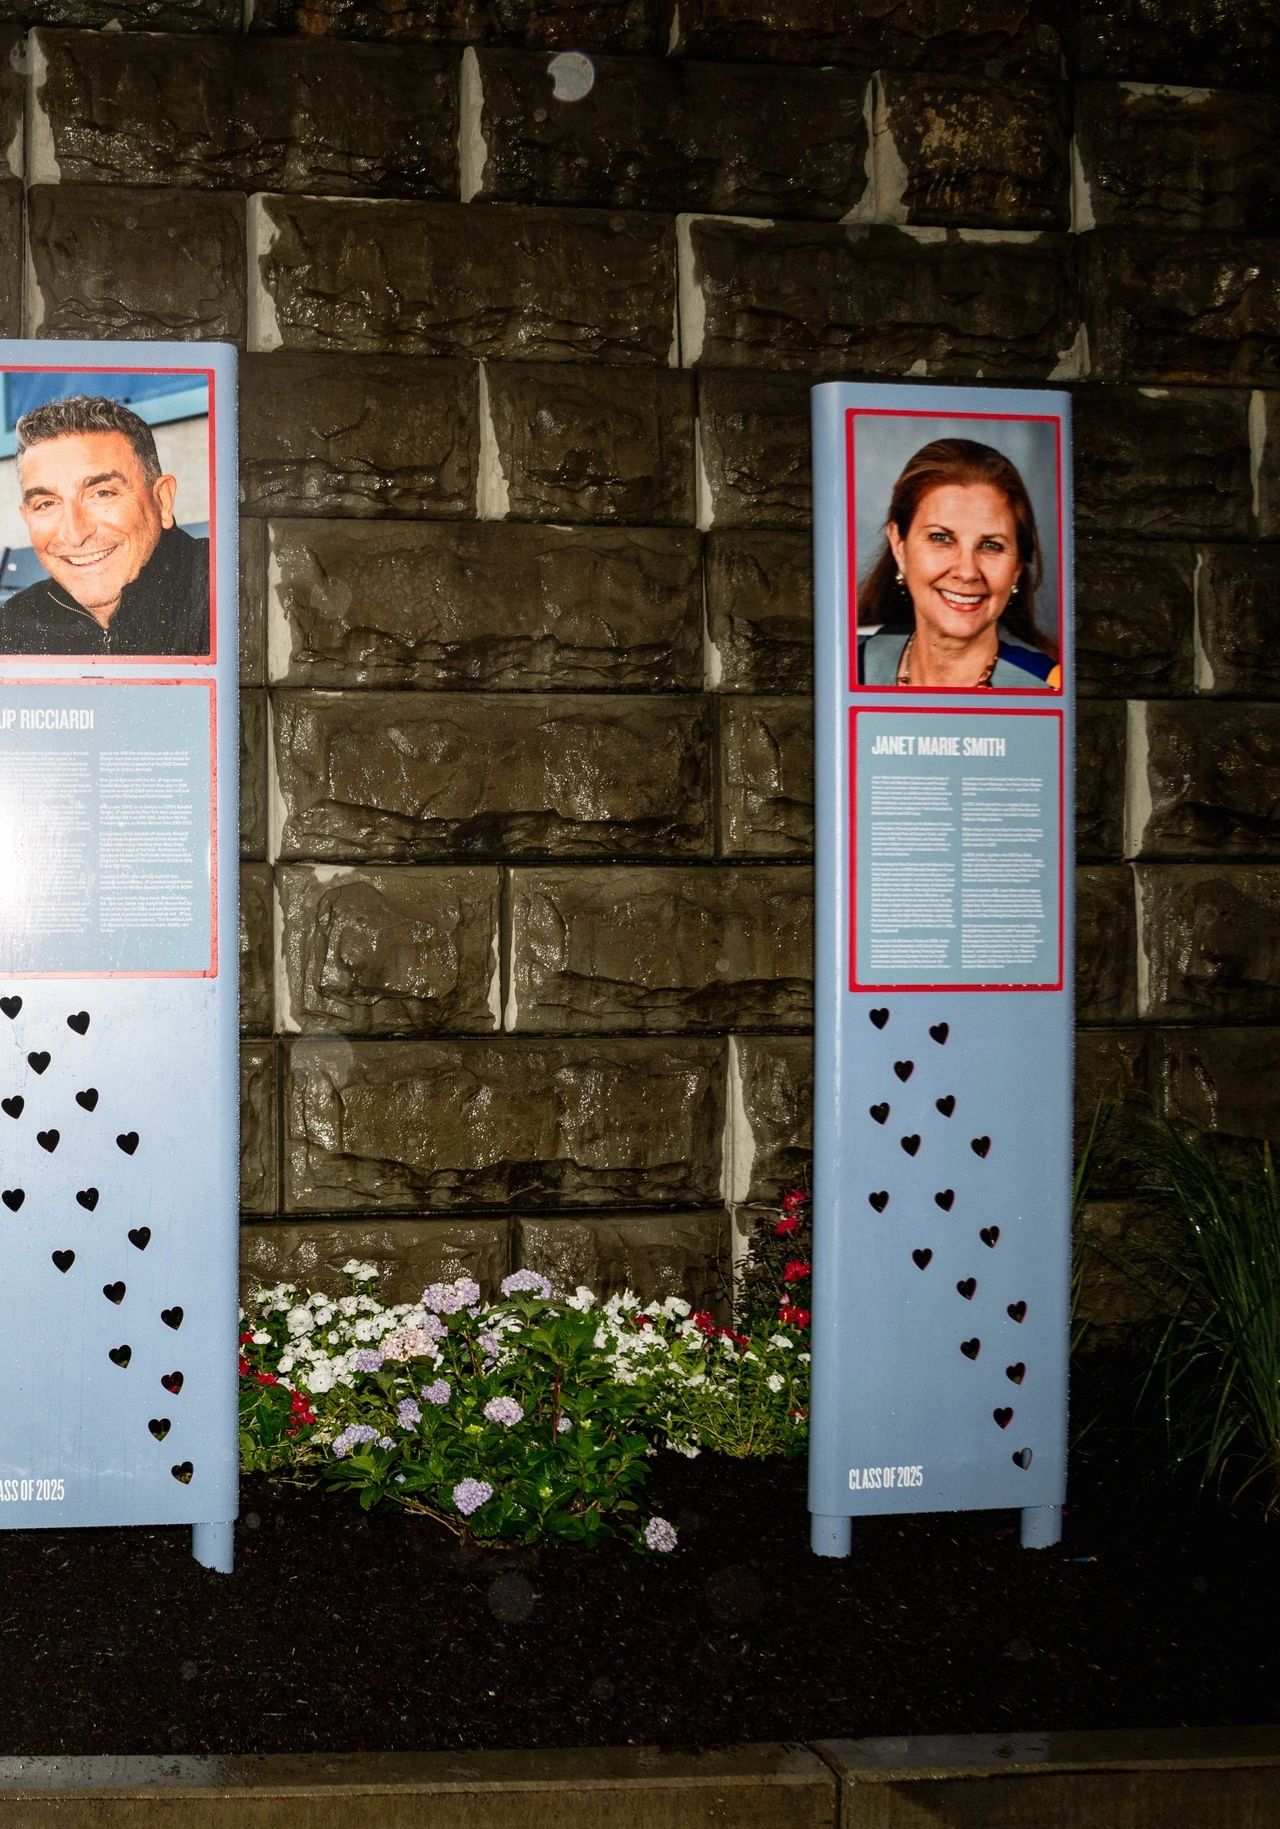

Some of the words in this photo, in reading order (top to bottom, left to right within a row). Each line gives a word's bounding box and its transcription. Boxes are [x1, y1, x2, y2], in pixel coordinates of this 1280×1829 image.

[20, 709, 95, 730] RICCIARDI
[871, 735, 916, 756] JANET
[917, 736, 961, 756] MARIE
[962, 736, 1006, 757] SMITH
[848, 1467, 883, 1490] CLASS
[882, 1466, 897, 1489] OF
[896, 1465, 924, 1488] 2025
[20, 1479, 35, 1501] OF
[35, 1478, 65, 1501] 2025
